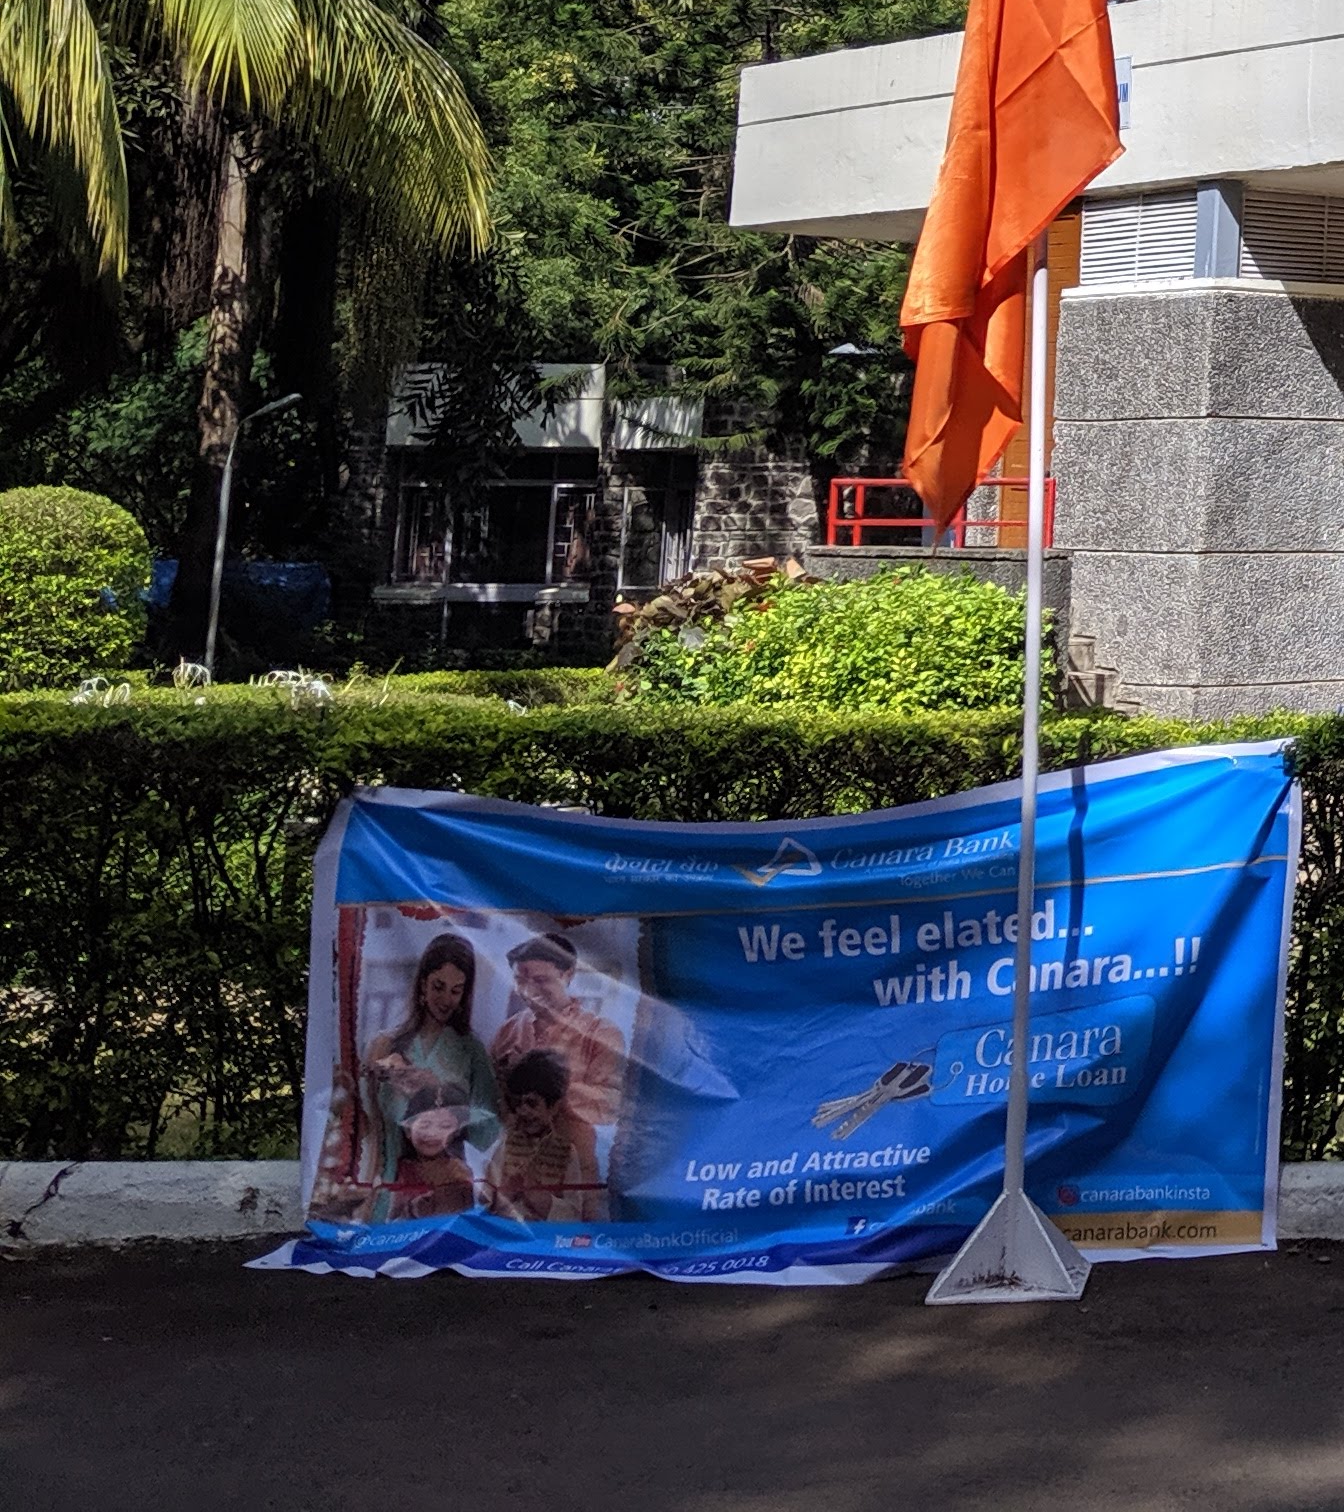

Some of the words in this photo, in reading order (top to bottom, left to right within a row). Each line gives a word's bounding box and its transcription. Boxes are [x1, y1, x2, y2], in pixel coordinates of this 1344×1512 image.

[830, 846, 934, 870] Canara
[943, 830, 1016, 858] Bank
[989, 865, 1016, 878] Can
[738, 924, 806, 963] We
[817, 914, 901, 958] feel
[916, 898, 1095, 953] elated...
[873, 960, 971, 1007] with
[965, 1072, 1044, 1097] Hoe
[1055, 1066, 1127, 1089] Loan
[685, 1160, 742, 1181] Low
[747, 1152, 798, 1179] and
[802, 1143, 931, 1173] Attractive
[701, 1188, 760, 1210] Rate
[768, 1179, 798, 1206] of
[804, 1175, 906, 1203] Interest
[1080, 1185, 1211, 1203] canarabankinsta
[1063, 1221, 1218, 1241] canarabank.com
[506, 1258, 543, 1270] Call
[683, 1262, 716, 1274] 425
[721, 1255, 770, 1271] 0018
